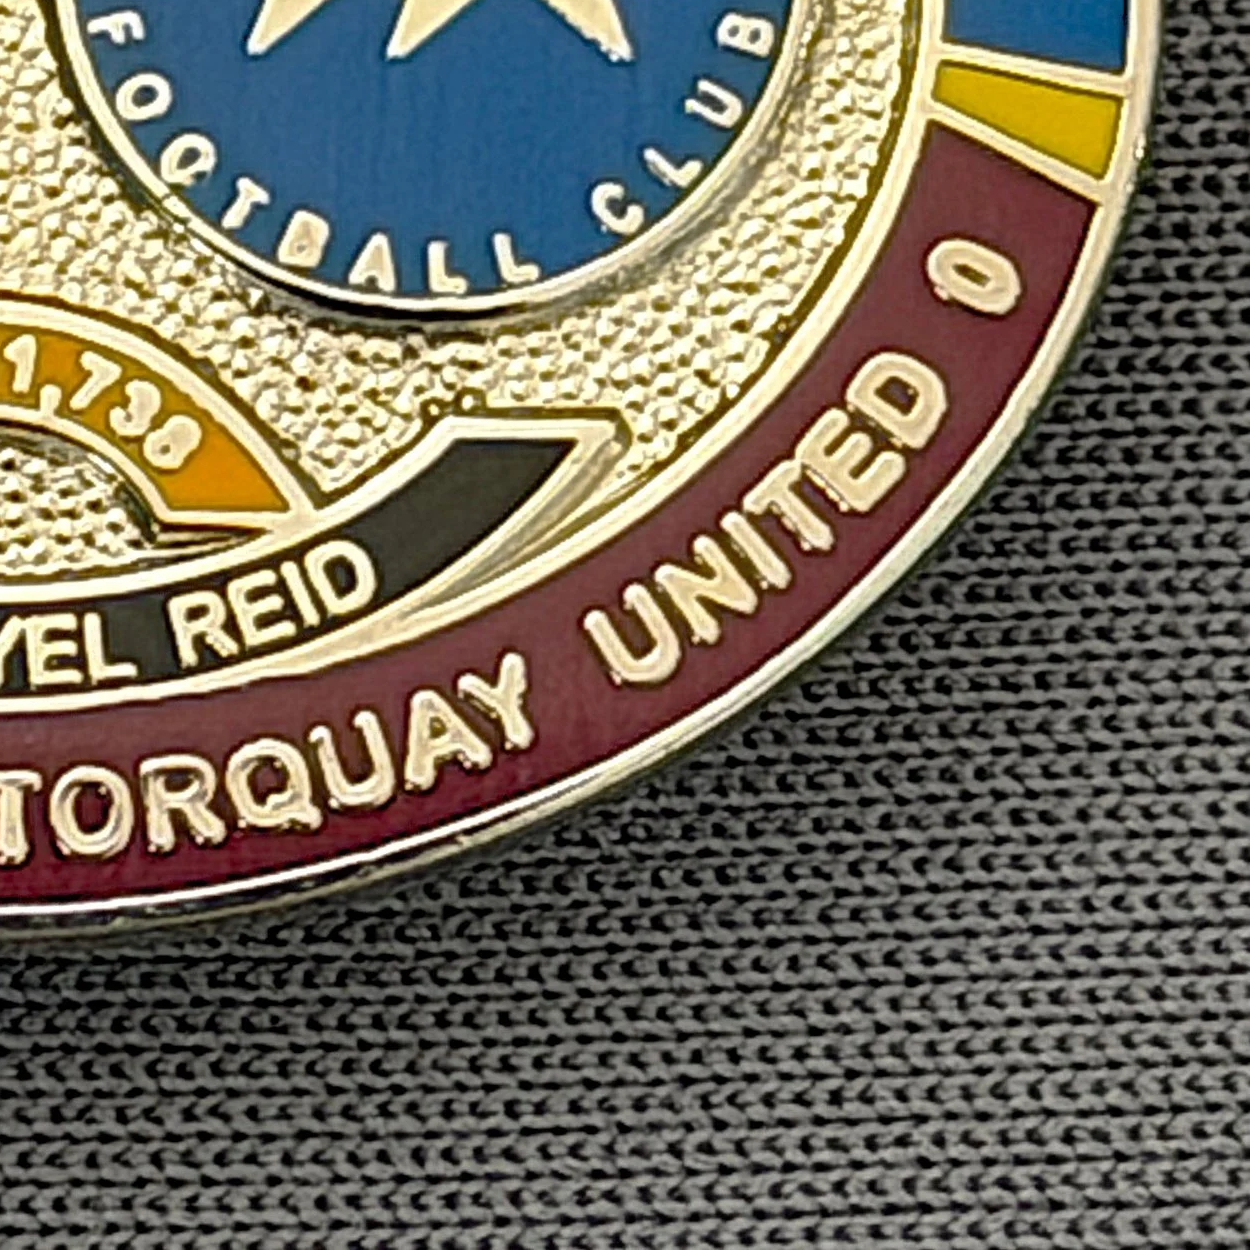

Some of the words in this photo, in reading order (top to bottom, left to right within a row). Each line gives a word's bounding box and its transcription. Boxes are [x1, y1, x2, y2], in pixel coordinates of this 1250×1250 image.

[88, 11, 540, 295] FOOTBALL
[591, 12, 774, 237] CLUB
[168, 543, 376, 668] REID
[581, 351, 949, 685] UNITED
